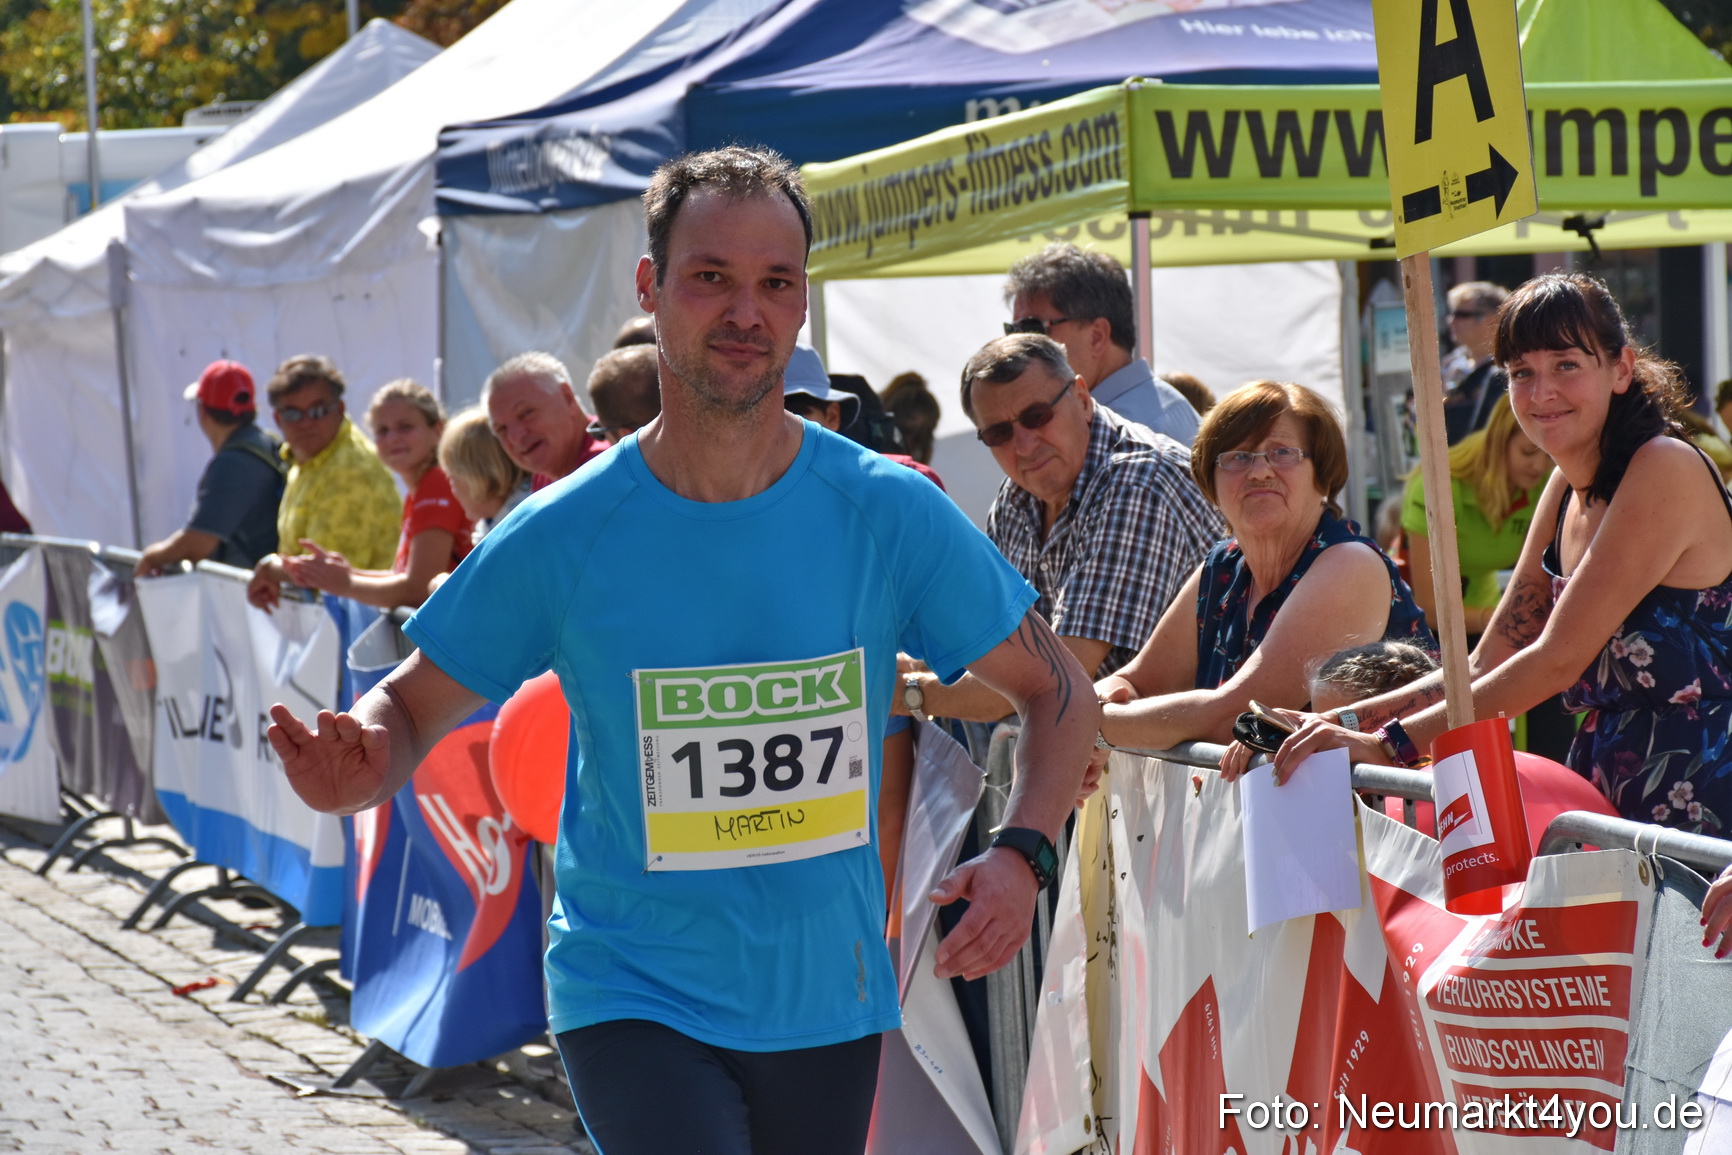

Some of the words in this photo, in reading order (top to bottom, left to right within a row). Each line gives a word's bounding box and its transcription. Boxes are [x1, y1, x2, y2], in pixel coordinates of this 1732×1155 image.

[1179, 18, 1244, 36] Hier
[1413, 0, 1495, 145] A
[656, 661, 851, 722] BOCK
[671, 726, 844, 799] 1387
[714, 809, 805, 841] MARTIN
[1446, 853, 1500, 879] protects.
[1403, 942, 1424, 996] 1929
[1437, 975, 1611, 1009] VERZURRSYSTEME
[1346, 1030, 1369, 1070] 1929
[1444, 1034, 1604, 1070] RUNDSCHLINGEN
